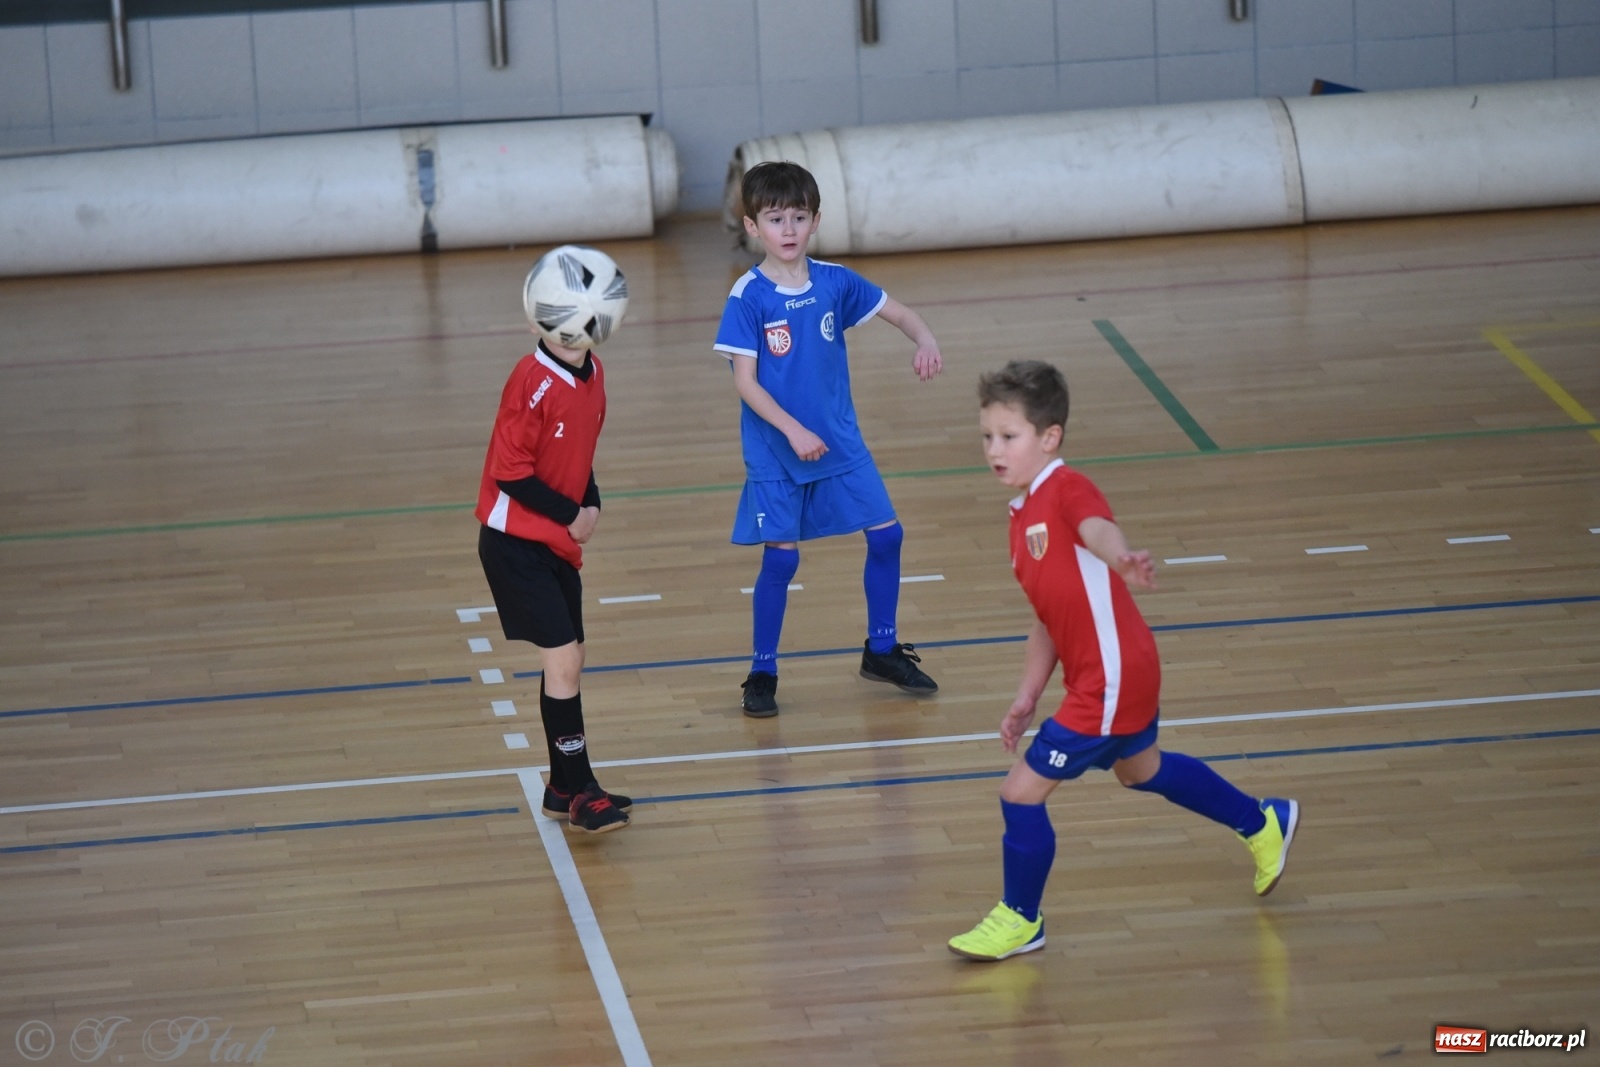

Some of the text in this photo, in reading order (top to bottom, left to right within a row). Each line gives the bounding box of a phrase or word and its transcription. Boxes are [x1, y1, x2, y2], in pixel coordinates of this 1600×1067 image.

[529, 375, 553, 410] LEGEA
[554, 422, 564, 438] 2
[1048, 750, 1068, 768] 18
